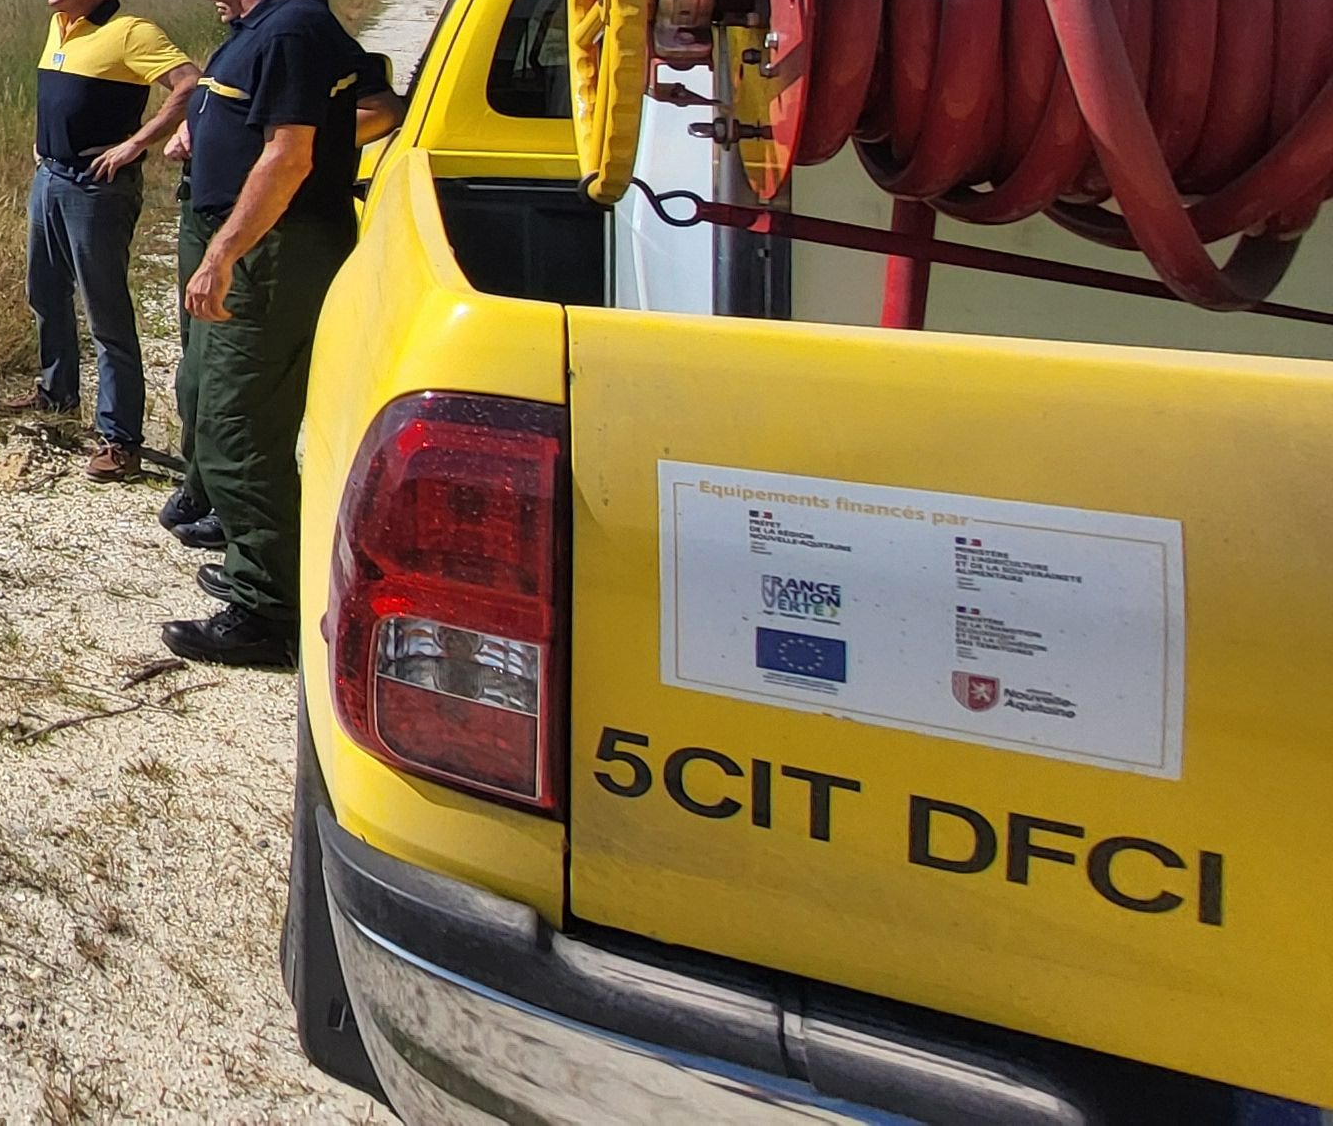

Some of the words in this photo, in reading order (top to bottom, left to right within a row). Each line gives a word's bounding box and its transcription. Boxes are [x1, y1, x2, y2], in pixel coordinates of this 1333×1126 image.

[699, 480, 830, 509] Equipements
[836, 497, 925, 521] financés
[931, 510, 969, 526] par
[592, 726, 861, 842] 5CIT
[908, 794, 1223, 927] DFCI
